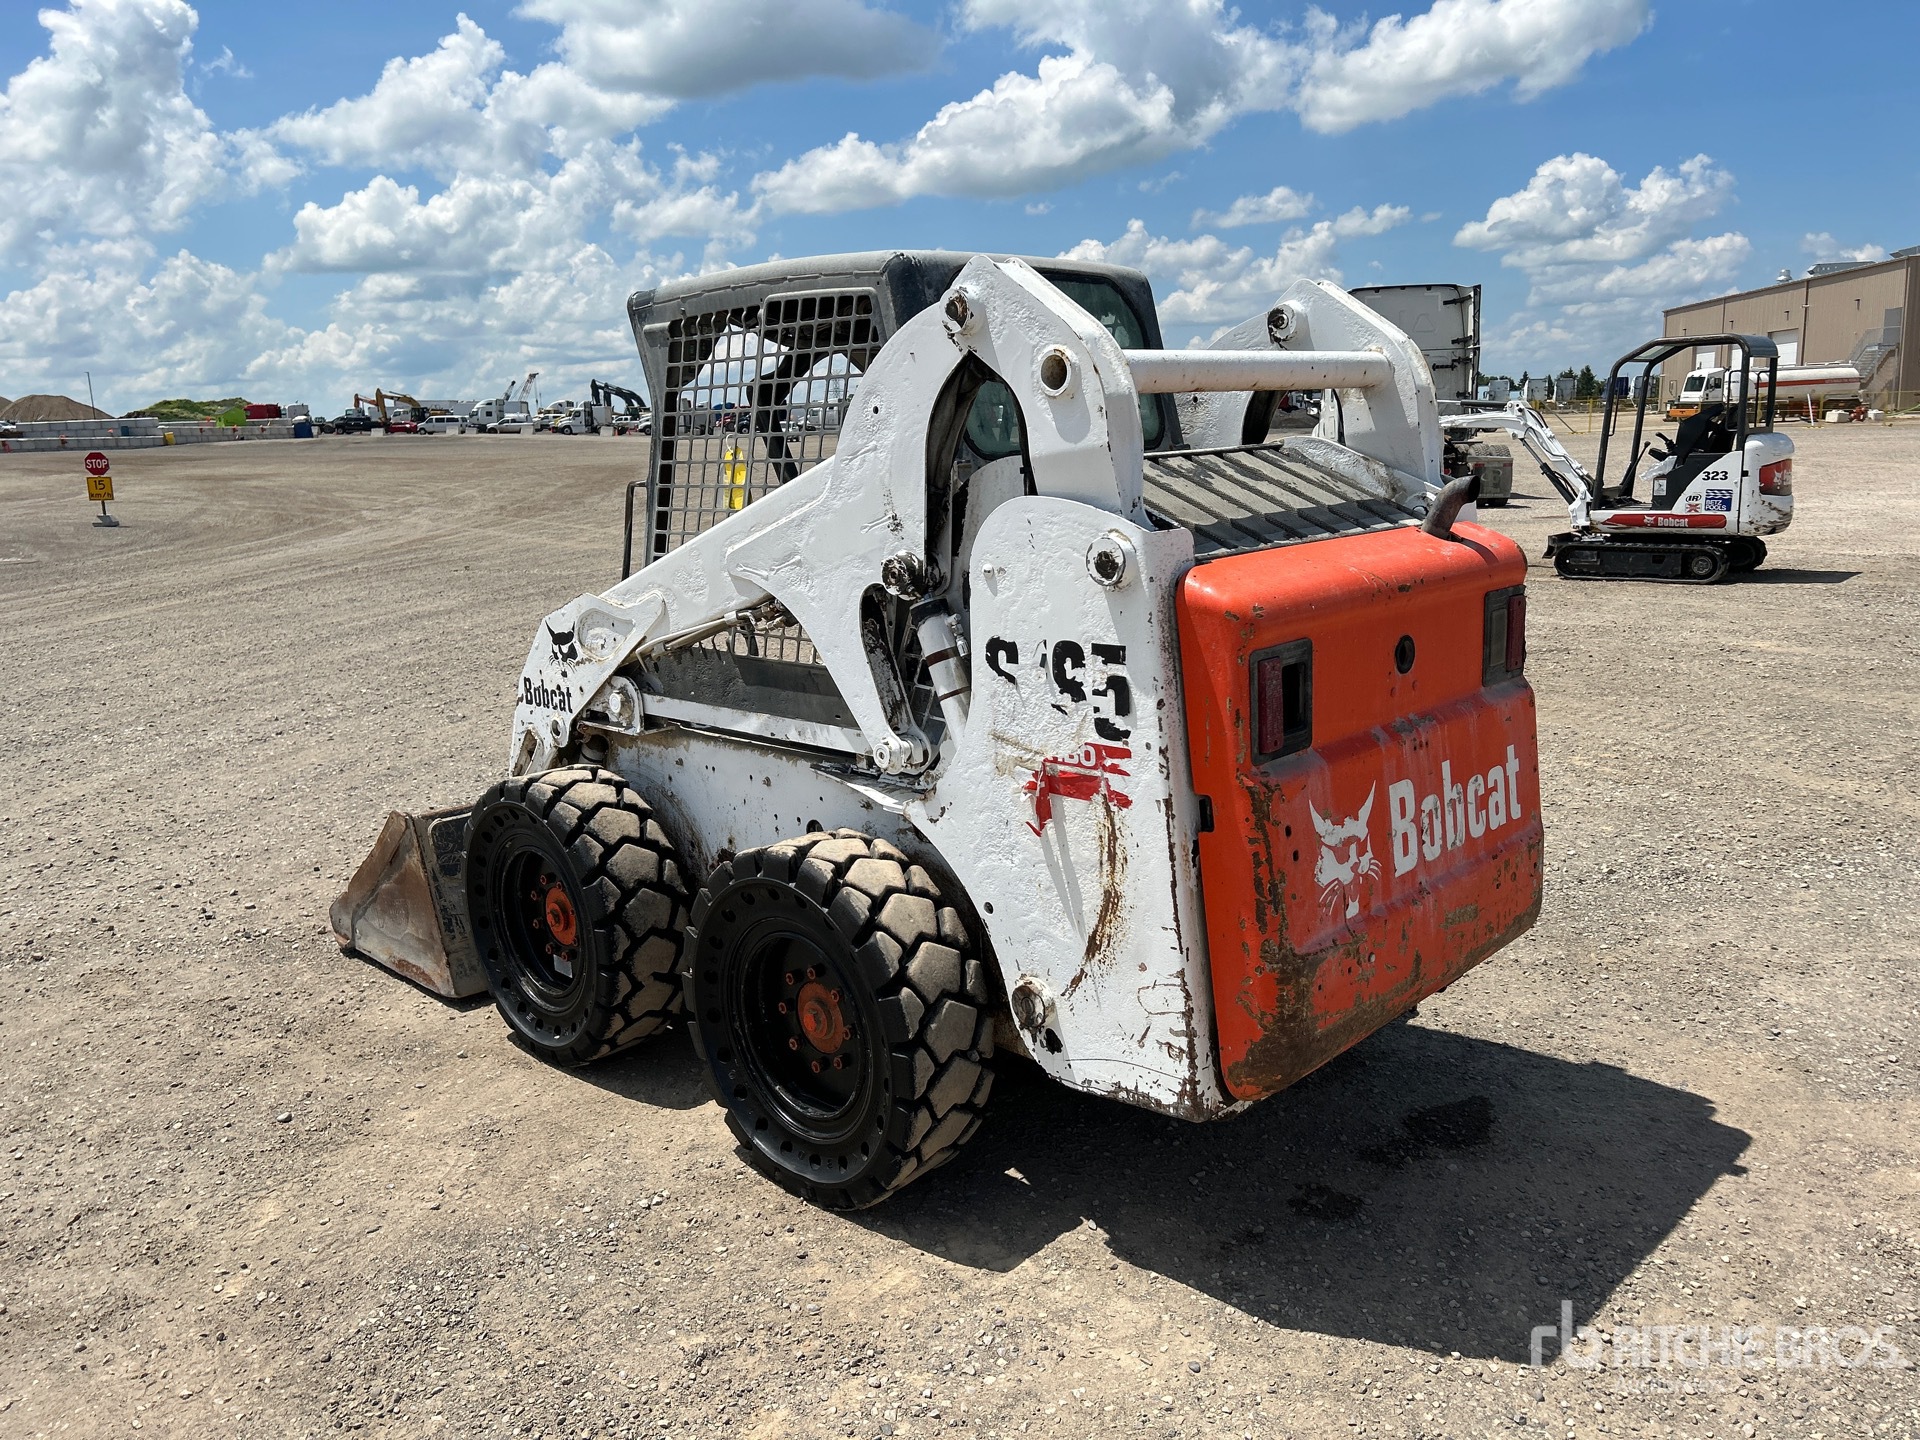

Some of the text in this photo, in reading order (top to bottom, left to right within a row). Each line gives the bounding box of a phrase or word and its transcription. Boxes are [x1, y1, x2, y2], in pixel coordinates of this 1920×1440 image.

[86, 459, 108, 468] STOP
[1702, 470, 1729, 481] 323
[93, 480, 106, 490] 15
[1657, 516, 1689, 528] Bobcat
[523, 676, 573, 714] Bobcat
[1388, 743, 1522, 878] Bobcat
